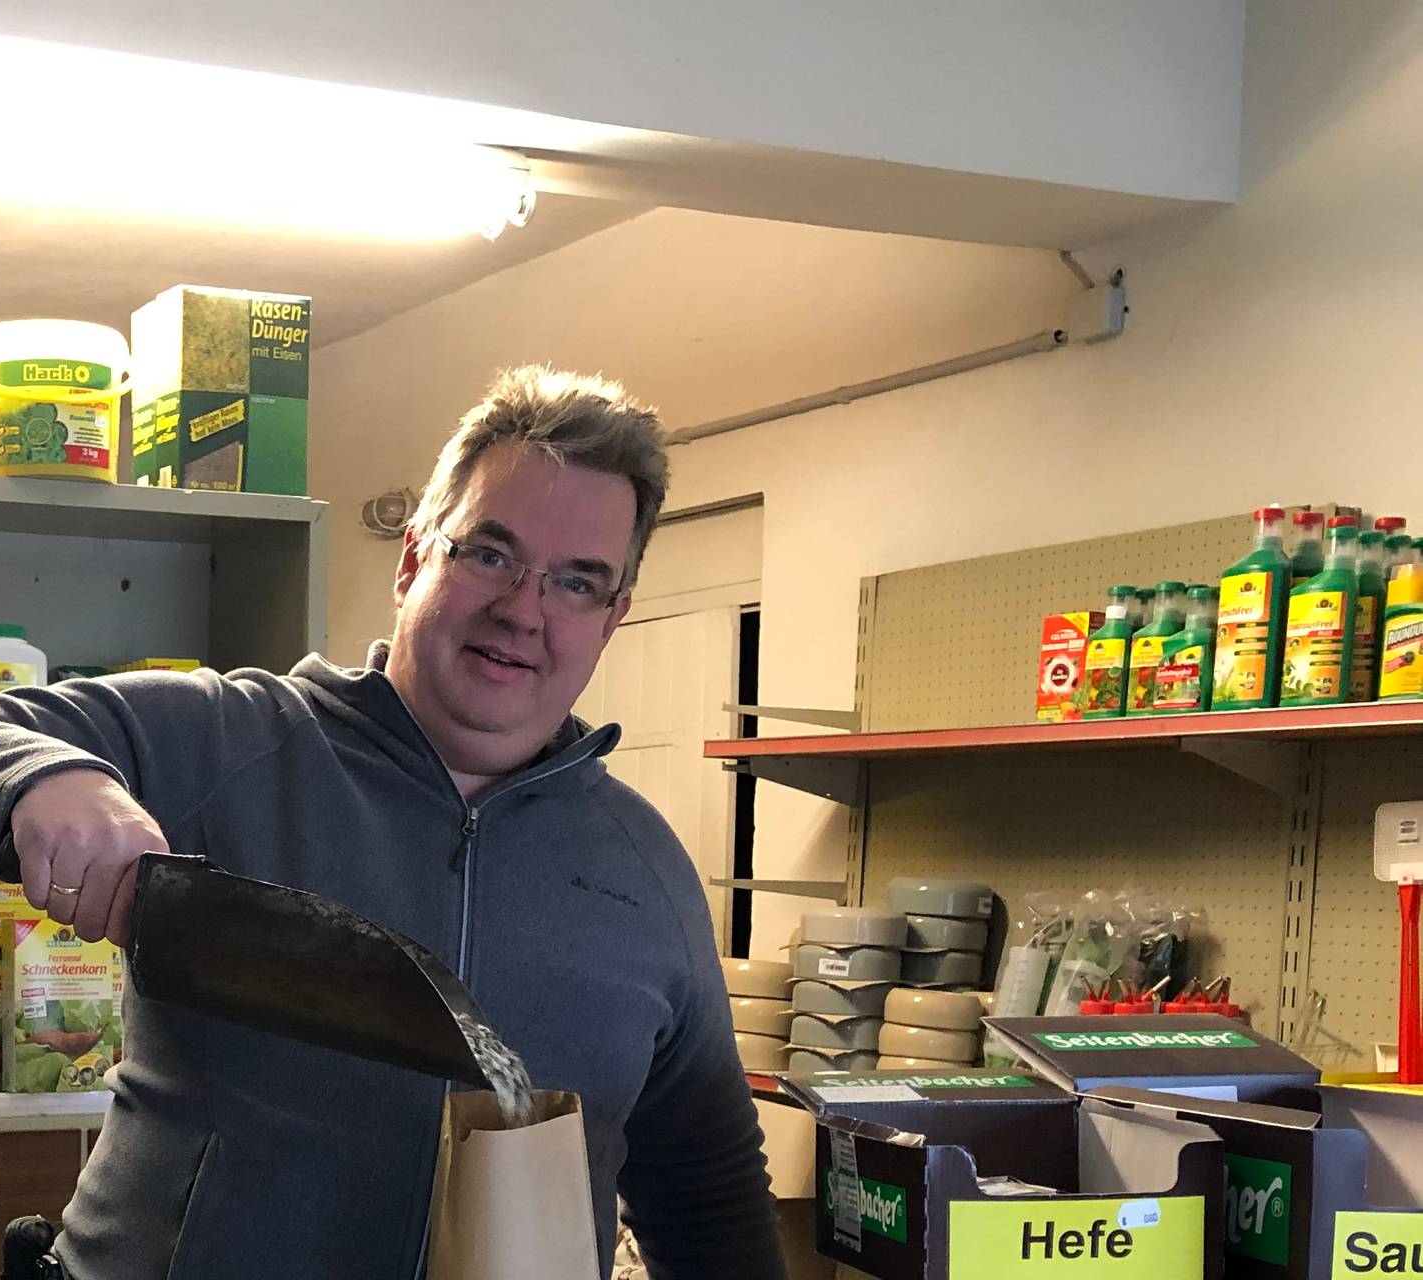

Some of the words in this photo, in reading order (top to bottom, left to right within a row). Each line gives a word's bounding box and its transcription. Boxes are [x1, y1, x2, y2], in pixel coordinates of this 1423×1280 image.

[251, 318, 309, 347] Dünger
[251, 345, 270, 358] mit
[273, 346, 302, 361] Eisen
[24, 363, 73, 381] Hack
[82, 448, 88, 456] 3
[89, 449, 99, 458] kg
[21, 964, 107, 975] Schneckenkorn
[1045, 1030, 1233, 1048] Seitenbacher
[823, 1075, 1013, 1087] Seitenbacher
[1022, 1219, 1133, 1260] Hefe
